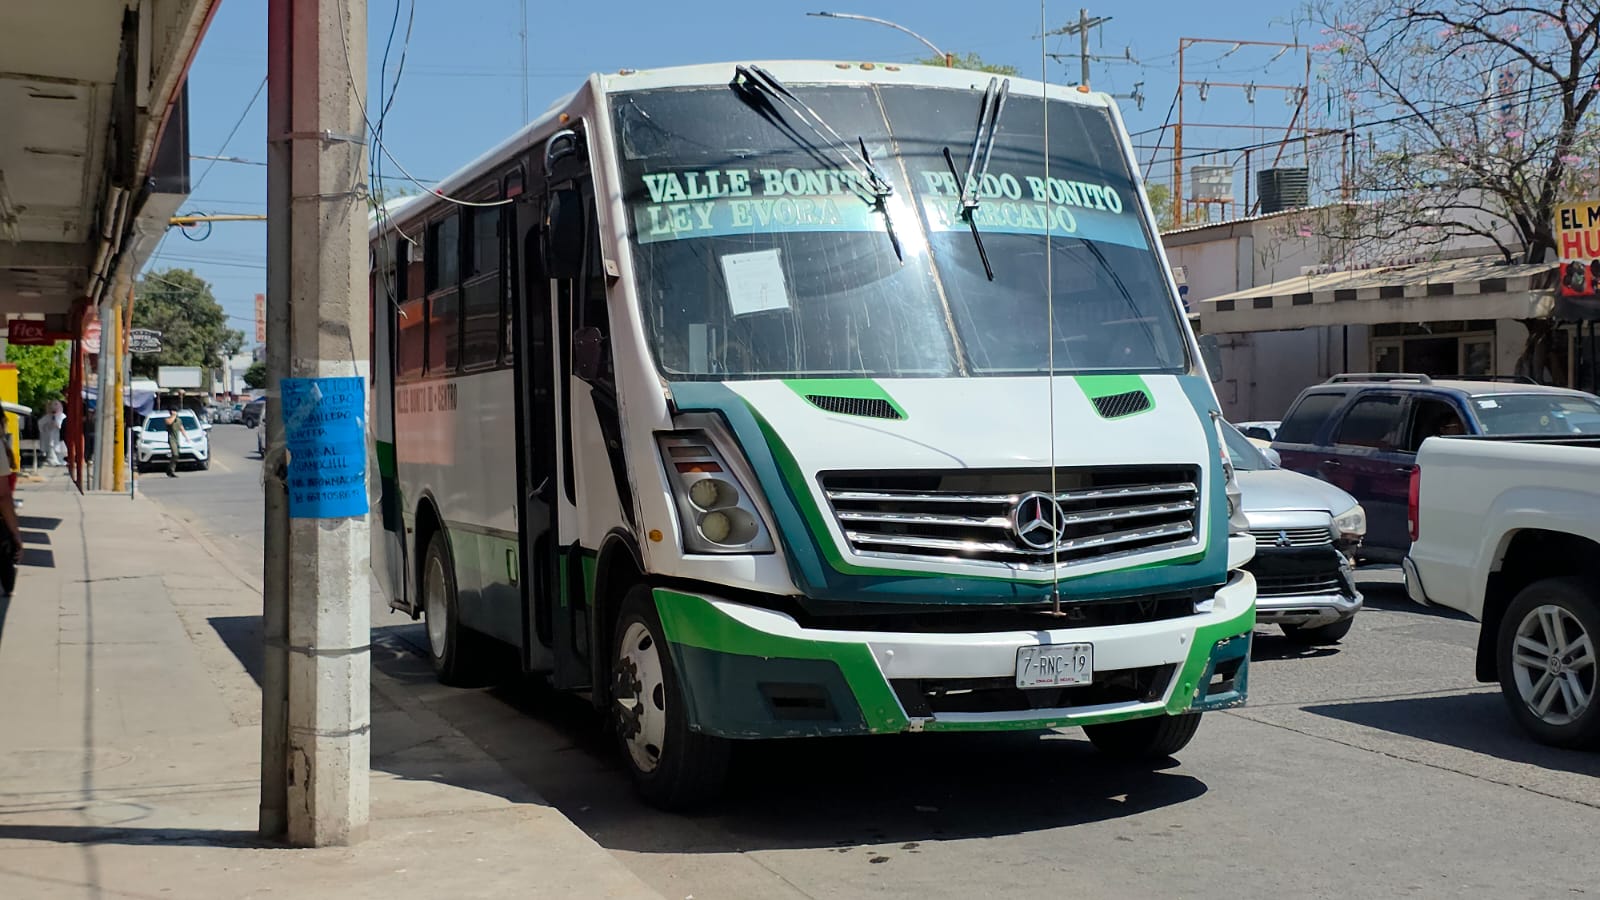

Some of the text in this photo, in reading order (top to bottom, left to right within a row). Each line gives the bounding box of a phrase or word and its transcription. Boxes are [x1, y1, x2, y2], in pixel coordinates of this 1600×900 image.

[642, 169, 752, 203] VALLE
[1026, 176, 1122, 214] BONITO
[647, 198, 842, 235] LEY EVORA
[926, 200, 1077, 233] MRCADO
[1561, 209, 1582, 229] EL
[1024, 655, 1086, 676] 7-RNC-19
